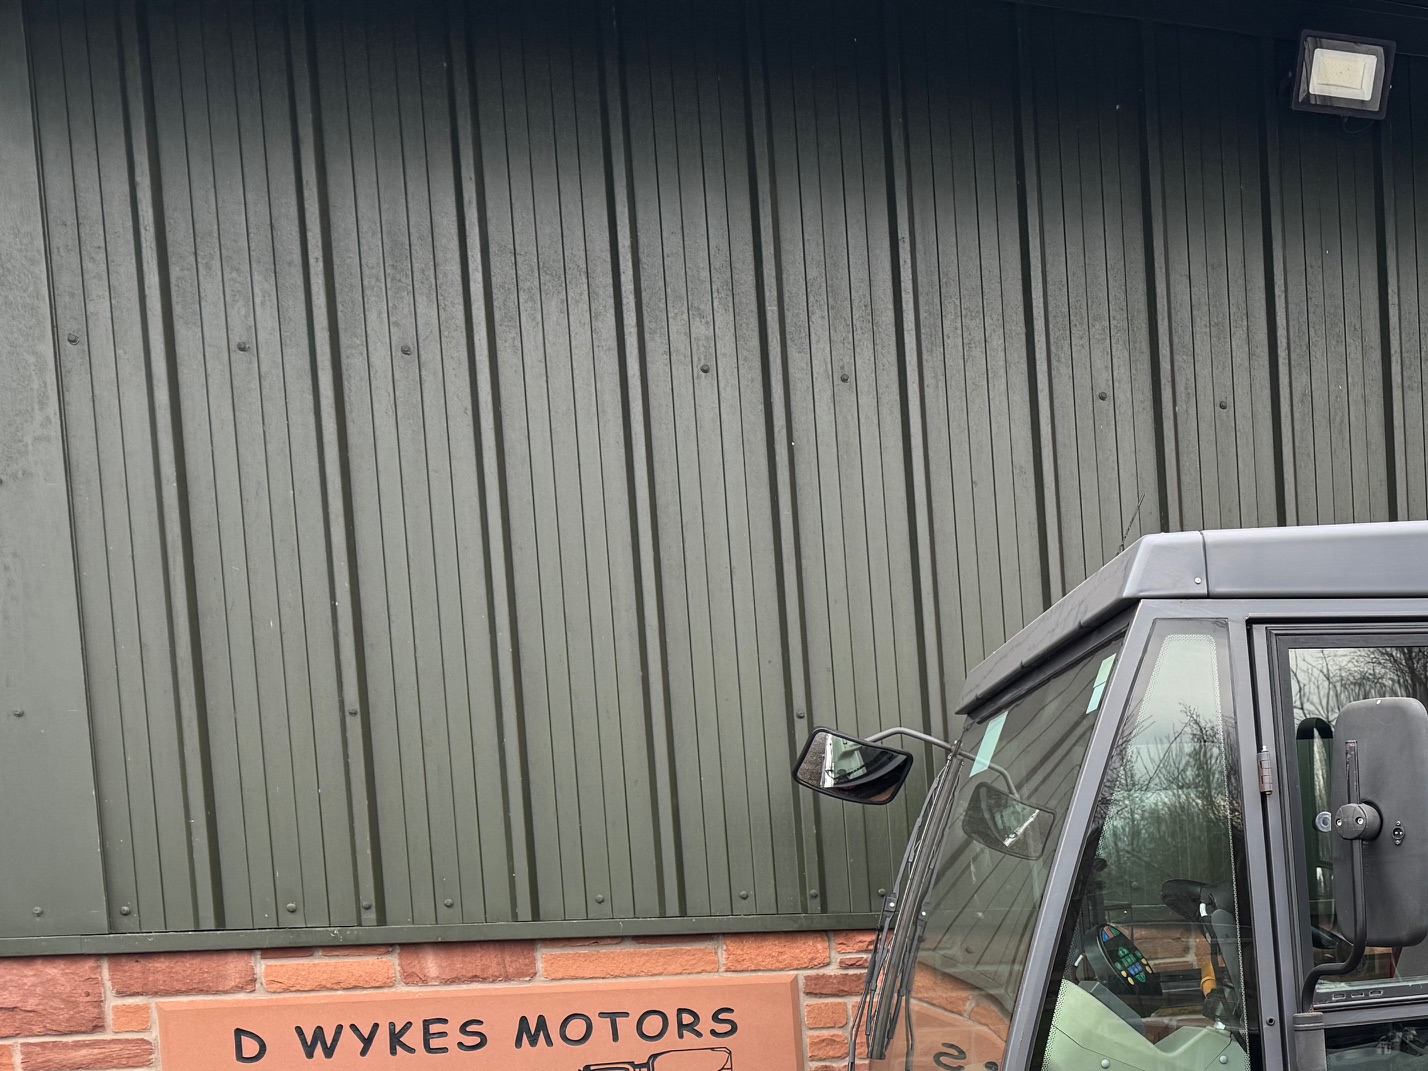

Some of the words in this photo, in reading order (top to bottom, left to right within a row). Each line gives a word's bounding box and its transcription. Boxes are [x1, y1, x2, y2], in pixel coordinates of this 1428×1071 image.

[233, 1027, 267, 1064] D
[294, 1014, 488, 1060] WYKES
[514, 1006, 738, 1049] MOTORS
